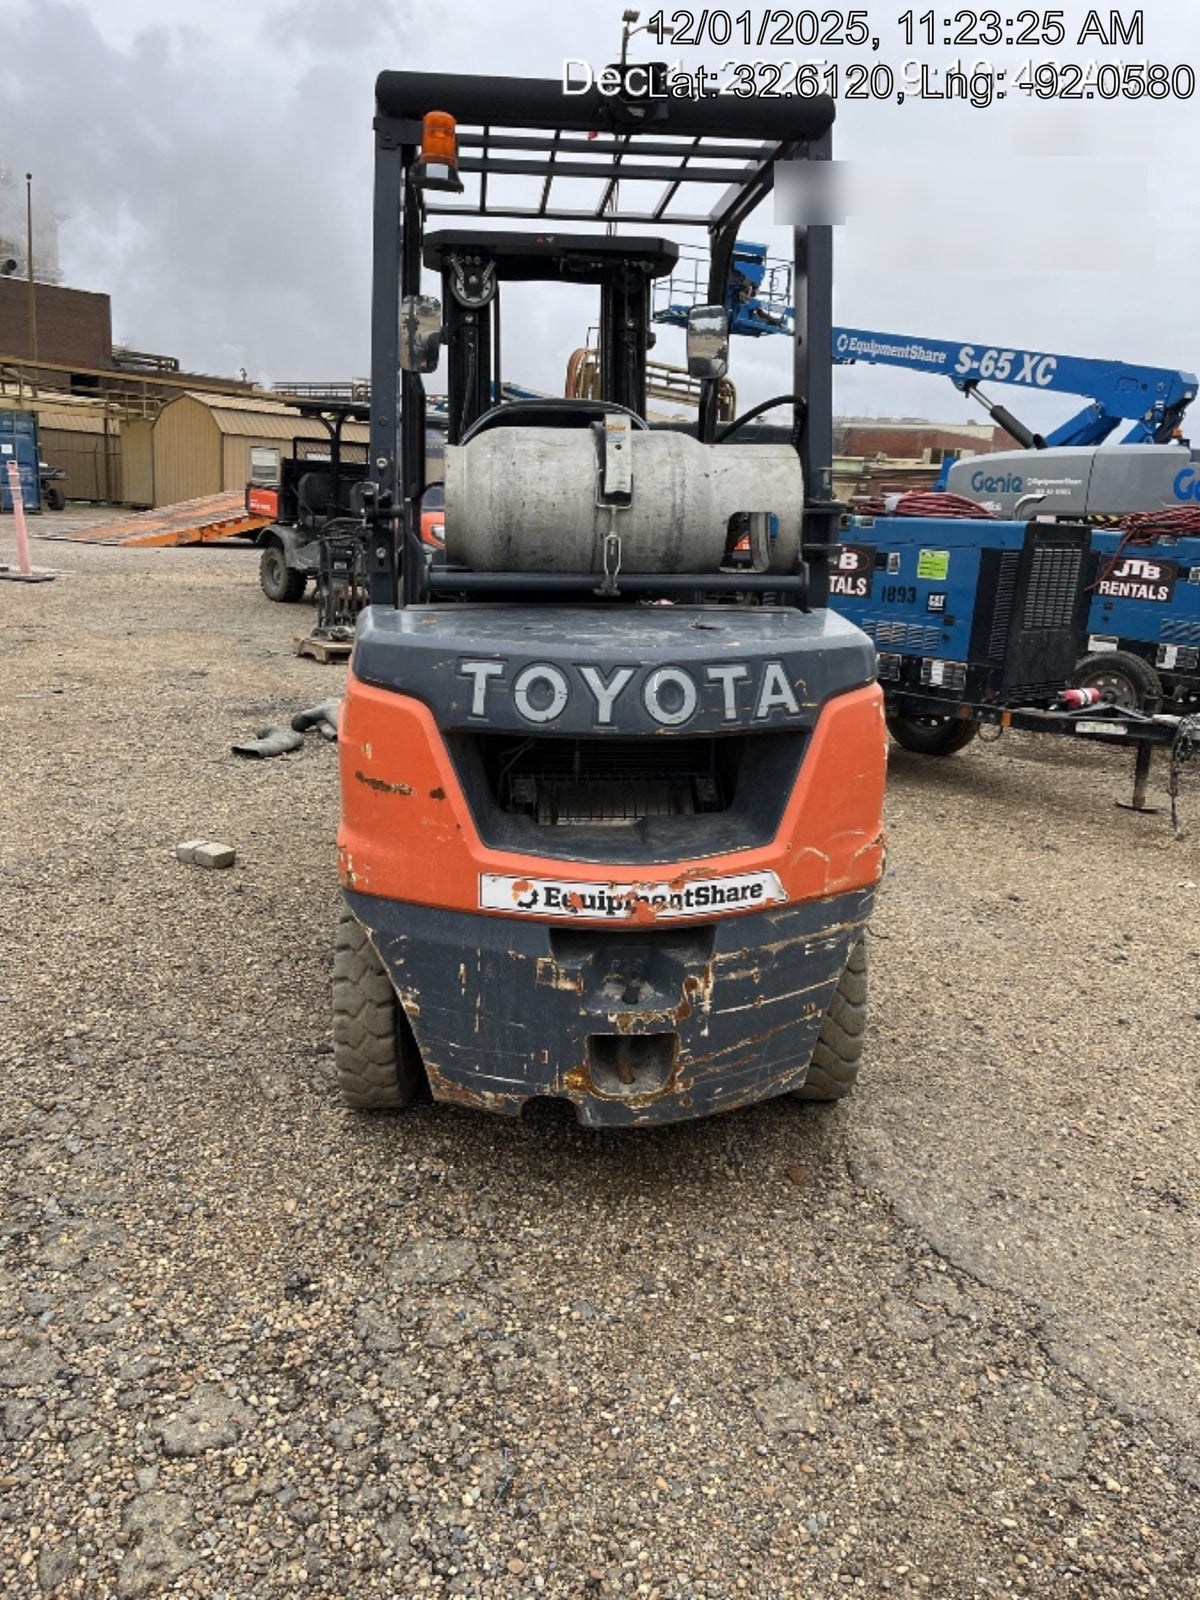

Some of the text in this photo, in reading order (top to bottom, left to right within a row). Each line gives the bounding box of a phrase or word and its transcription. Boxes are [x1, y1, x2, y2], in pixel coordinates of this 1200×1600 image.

[848, 337, 946, 363] EquipmentShare
[954, 346, 1057, 386] S-65 XC
[971, 470, 1023, 493] Genie
[1113, 560, 1161, 579] JTB
[881, 586, 917, 604] 1893
[1099, 580, 1169, 600] RENTALS
[928, 595, 946, 607] CAT
[460, 660, 800, 726] TOYOTA
